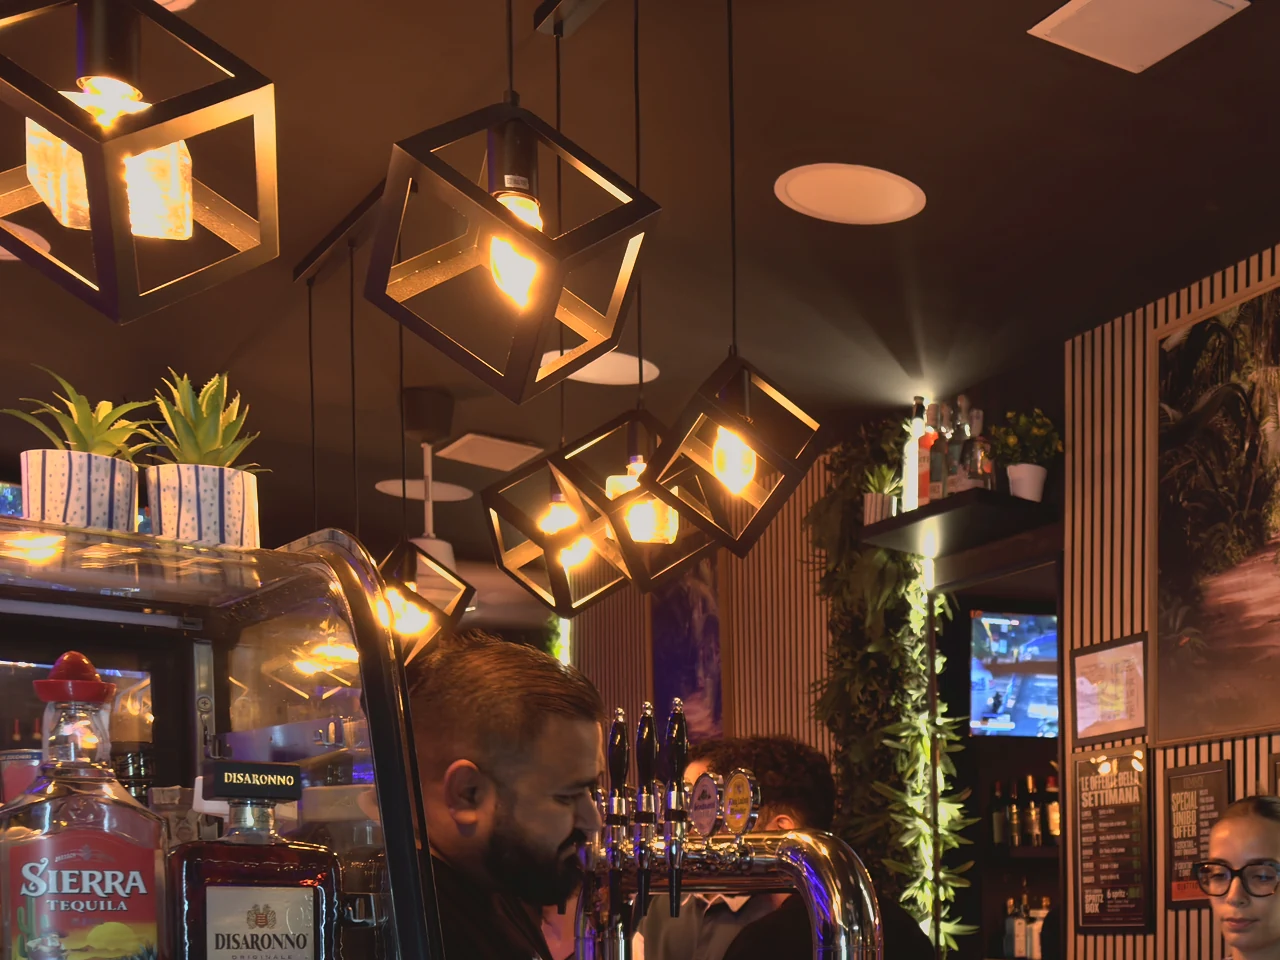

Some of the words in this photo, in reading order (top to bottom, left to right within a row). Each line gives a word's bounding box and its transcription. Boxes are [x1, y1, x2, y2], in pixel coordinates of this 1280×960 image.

[224, 771, 294, 787] DISARONNO
[1081, 786, 1140, 808] SETTIMANA
[1172, 790, 1197, 812] SPECIAL
[1173, 809, 1197, 826] UNIBO
[1173, 824, 1197, 839] OFFER
[20, 857, 148, 898] SIERRA
[46, 899, 129, 913] TEQUILA
[1085, 903, 1100, 914] BOX
[214, 933, 307, 951] DISARONNO
